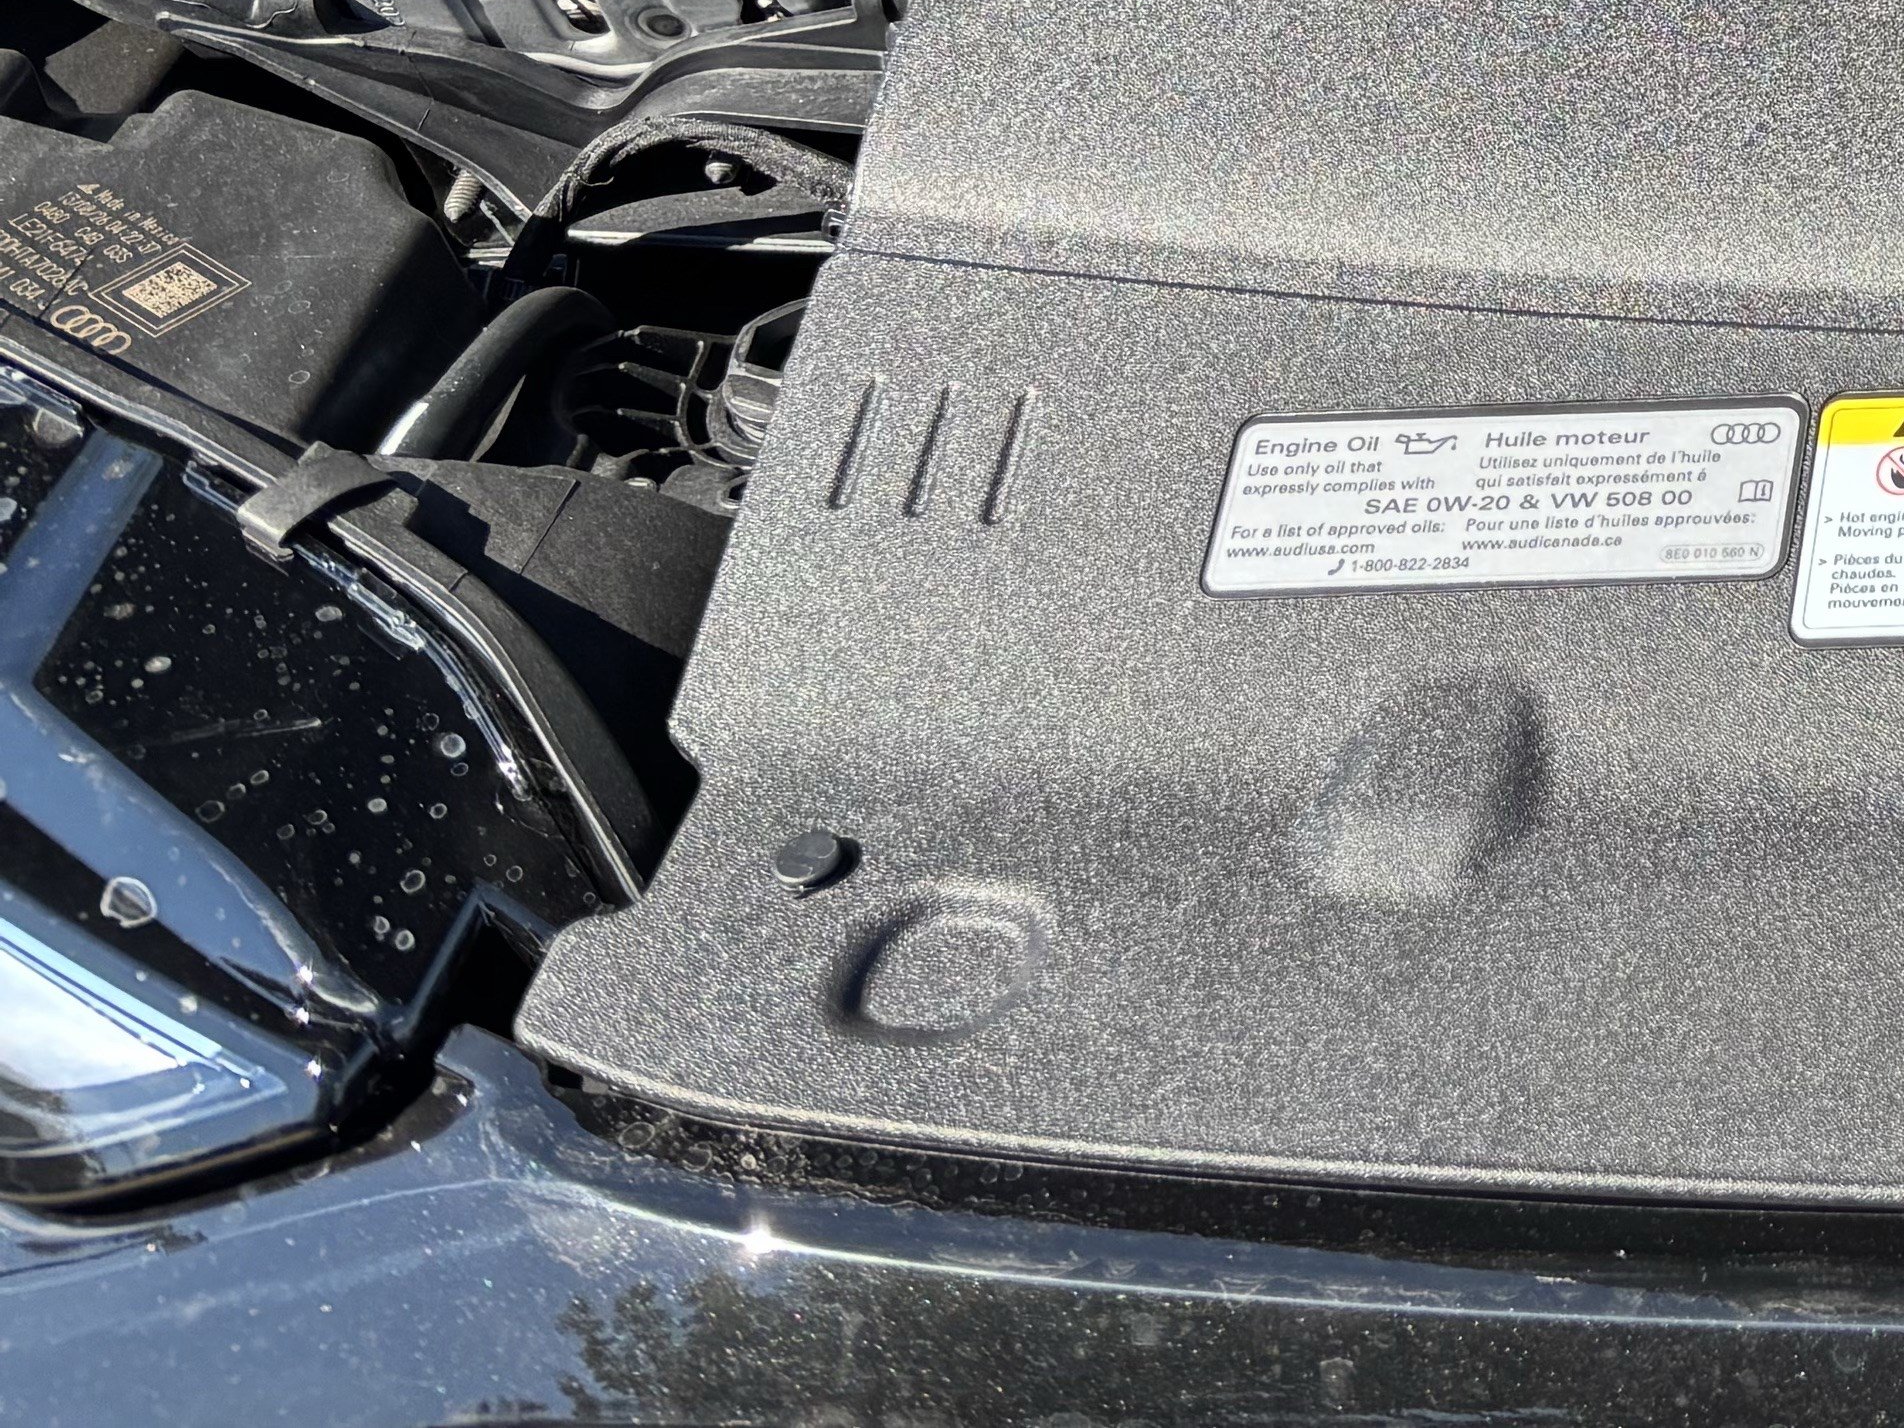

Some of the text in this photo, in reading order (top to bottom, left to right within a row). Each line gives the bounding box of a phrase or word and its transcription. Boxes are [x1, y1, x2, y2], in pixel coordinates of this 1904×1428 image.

[1255, 430, 1650, 457] Engine Oil Huile moteur
[1480, 450, 1721, 470] Utilisez uniquement de l'huile
[1248, 460, 1382, 477] Use only oil that
[1242, 477, 1435, 497] expressly complies with
[1475, 474, 1502, 488] qui
[1506, 472, 1570, 486] satisfait
[1576, 470, 1692, 486] expressément
[1364, 490, 1693, 515] SAE 0W-20 & VW 508 00
[1465, 518, 1506, 530] Pour
[1509, 518, 1539, 530] une
[1545, 516, 1579, 529] liste
[1840, 512, 1866, 524] Hot
[1231, 519, 1446, 540] For a list of approved oils:
[1838, 526, 1895, 540] Moving
[1227, 541, 1375, 558] www.audiusa.com
[1462, 534, 1622, 550] www.audicanada.ca
[1352, 557, 1469, 572] 1-800-822-2834
[1834, 553, 1880, 565] Pièces
[1885, 552, 1904, 565] du
[1831, 569, 1896, 580] chaudes.
[1830, 582, 1899, 594] Pièces en
